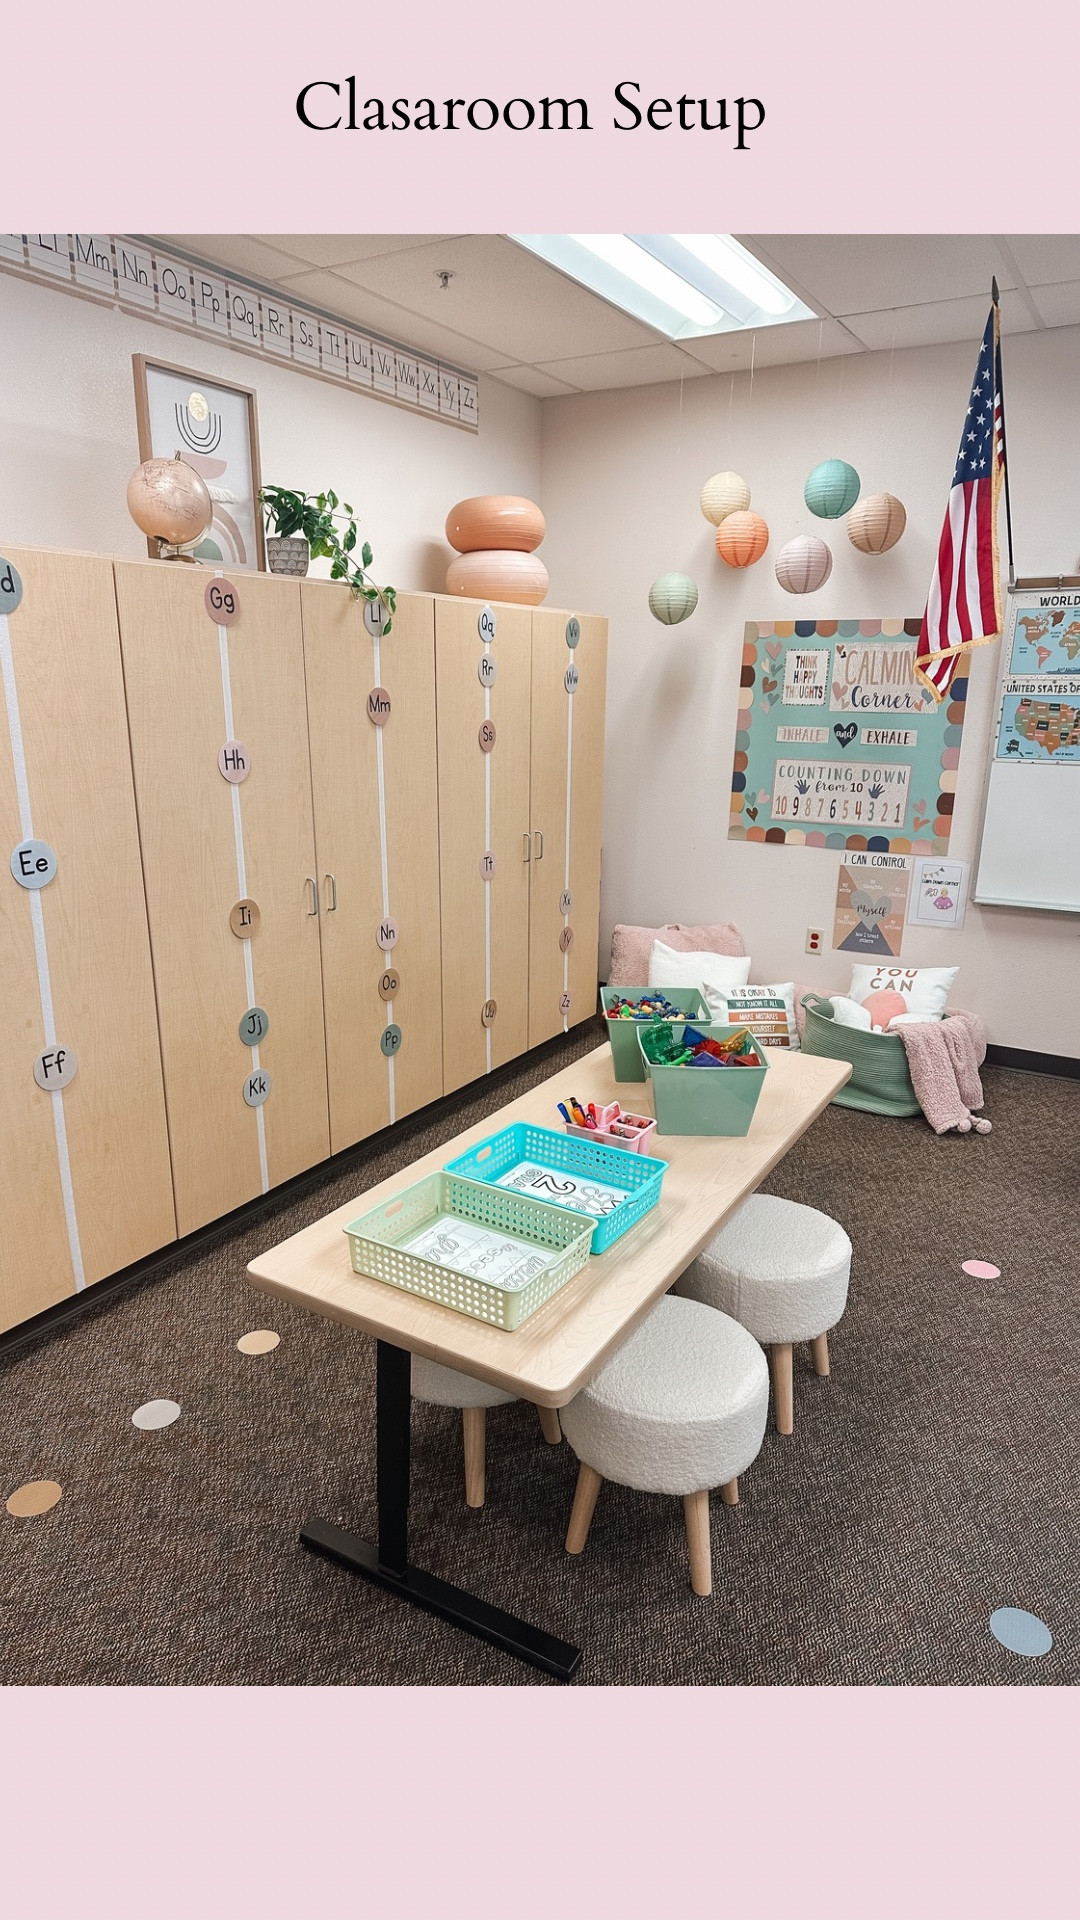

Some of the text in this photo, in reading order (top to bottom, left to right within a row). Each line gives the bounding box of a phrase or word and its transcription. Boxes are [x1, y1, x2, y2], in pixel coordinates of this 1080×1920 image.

[75, 234, 111, 270] Mm
[122, 250, 148, 286] Nn
[162, 268, 187, 300] Oo
[201, 281, 220, 323] Pp
[232, 295, 258, 338] Qq
[268, 308, 284, 336] Rr
[299, 321, 314, 347] Ss
[326, 331, 340, 357] Tt
[351, 342, 368, 368] Uu
[377, 352, 391, 377] Vv
[398, 362, 416, 386] Ww
[422, 370, 436, 395] Xx
[443, 379, 455, 410] Yy
[463, 387, 475, 409] Zz
[209, 586, 235, 613] Gg
[1040, 596, 1080, 606] WORLD
[370, 603, 382, 623] Ll
[481, 613, 495, 638] Qq
[482, 659, 494, 676] Rr
[796, 655, 818, 669] THINK
[845, 650, 924, 686] CALMIN
[566, 671, 579, 685] Ww
[793, 670, 818, 684] HAPPY
[785, 685, 823, 699] THOUGHTS
[852, 685, 915, 709] Corner
[1006, 684, 1035, 693] UNITED
[1037, 685, 1068, 693] STATES
[368, 694, 391, 713] Mm
[482, 725, 493, 742] Ss
[782, 723, 911, 745] INHALE and EXHALE
[223, 749, 246, 771] Hh
[779, 765, 906, 785] COUNTING DOWN
[815, 780, 864, 793] from 10
[776, 795, 901, 823] 10 9 8 7 6 5 4 3 2 1
[18, 850, 48, 876] Ee
[483, 856, 493, 872] Tt
[851, 854, 867, 865] CAN
[871, 855, 907, 869] CONTROL
[562, 893, 571, 906] Xx
[239, 906, 252, 926] Ii
[857, 904, 887, 917] Myself
[380, 925, 396, 942] Nn
[563, 930, 572, 947] Yy
[876, 968, 918, 978] YOU
[382, 974, 397, 991] Oo
[870, 978, 913, 992] CAN
[561, 994, 571, 1008] Zz
[247, 1014, 263, 1037] Jj
[751, 1025, 776, 1033] YOURSELF
[385, 1031, 398, 1049] Pp
[769, 1037, 782, 1045] DAYS
[41, 1050, 66, 1079] Ff
[248, 1076, 266, 1098] Kk
